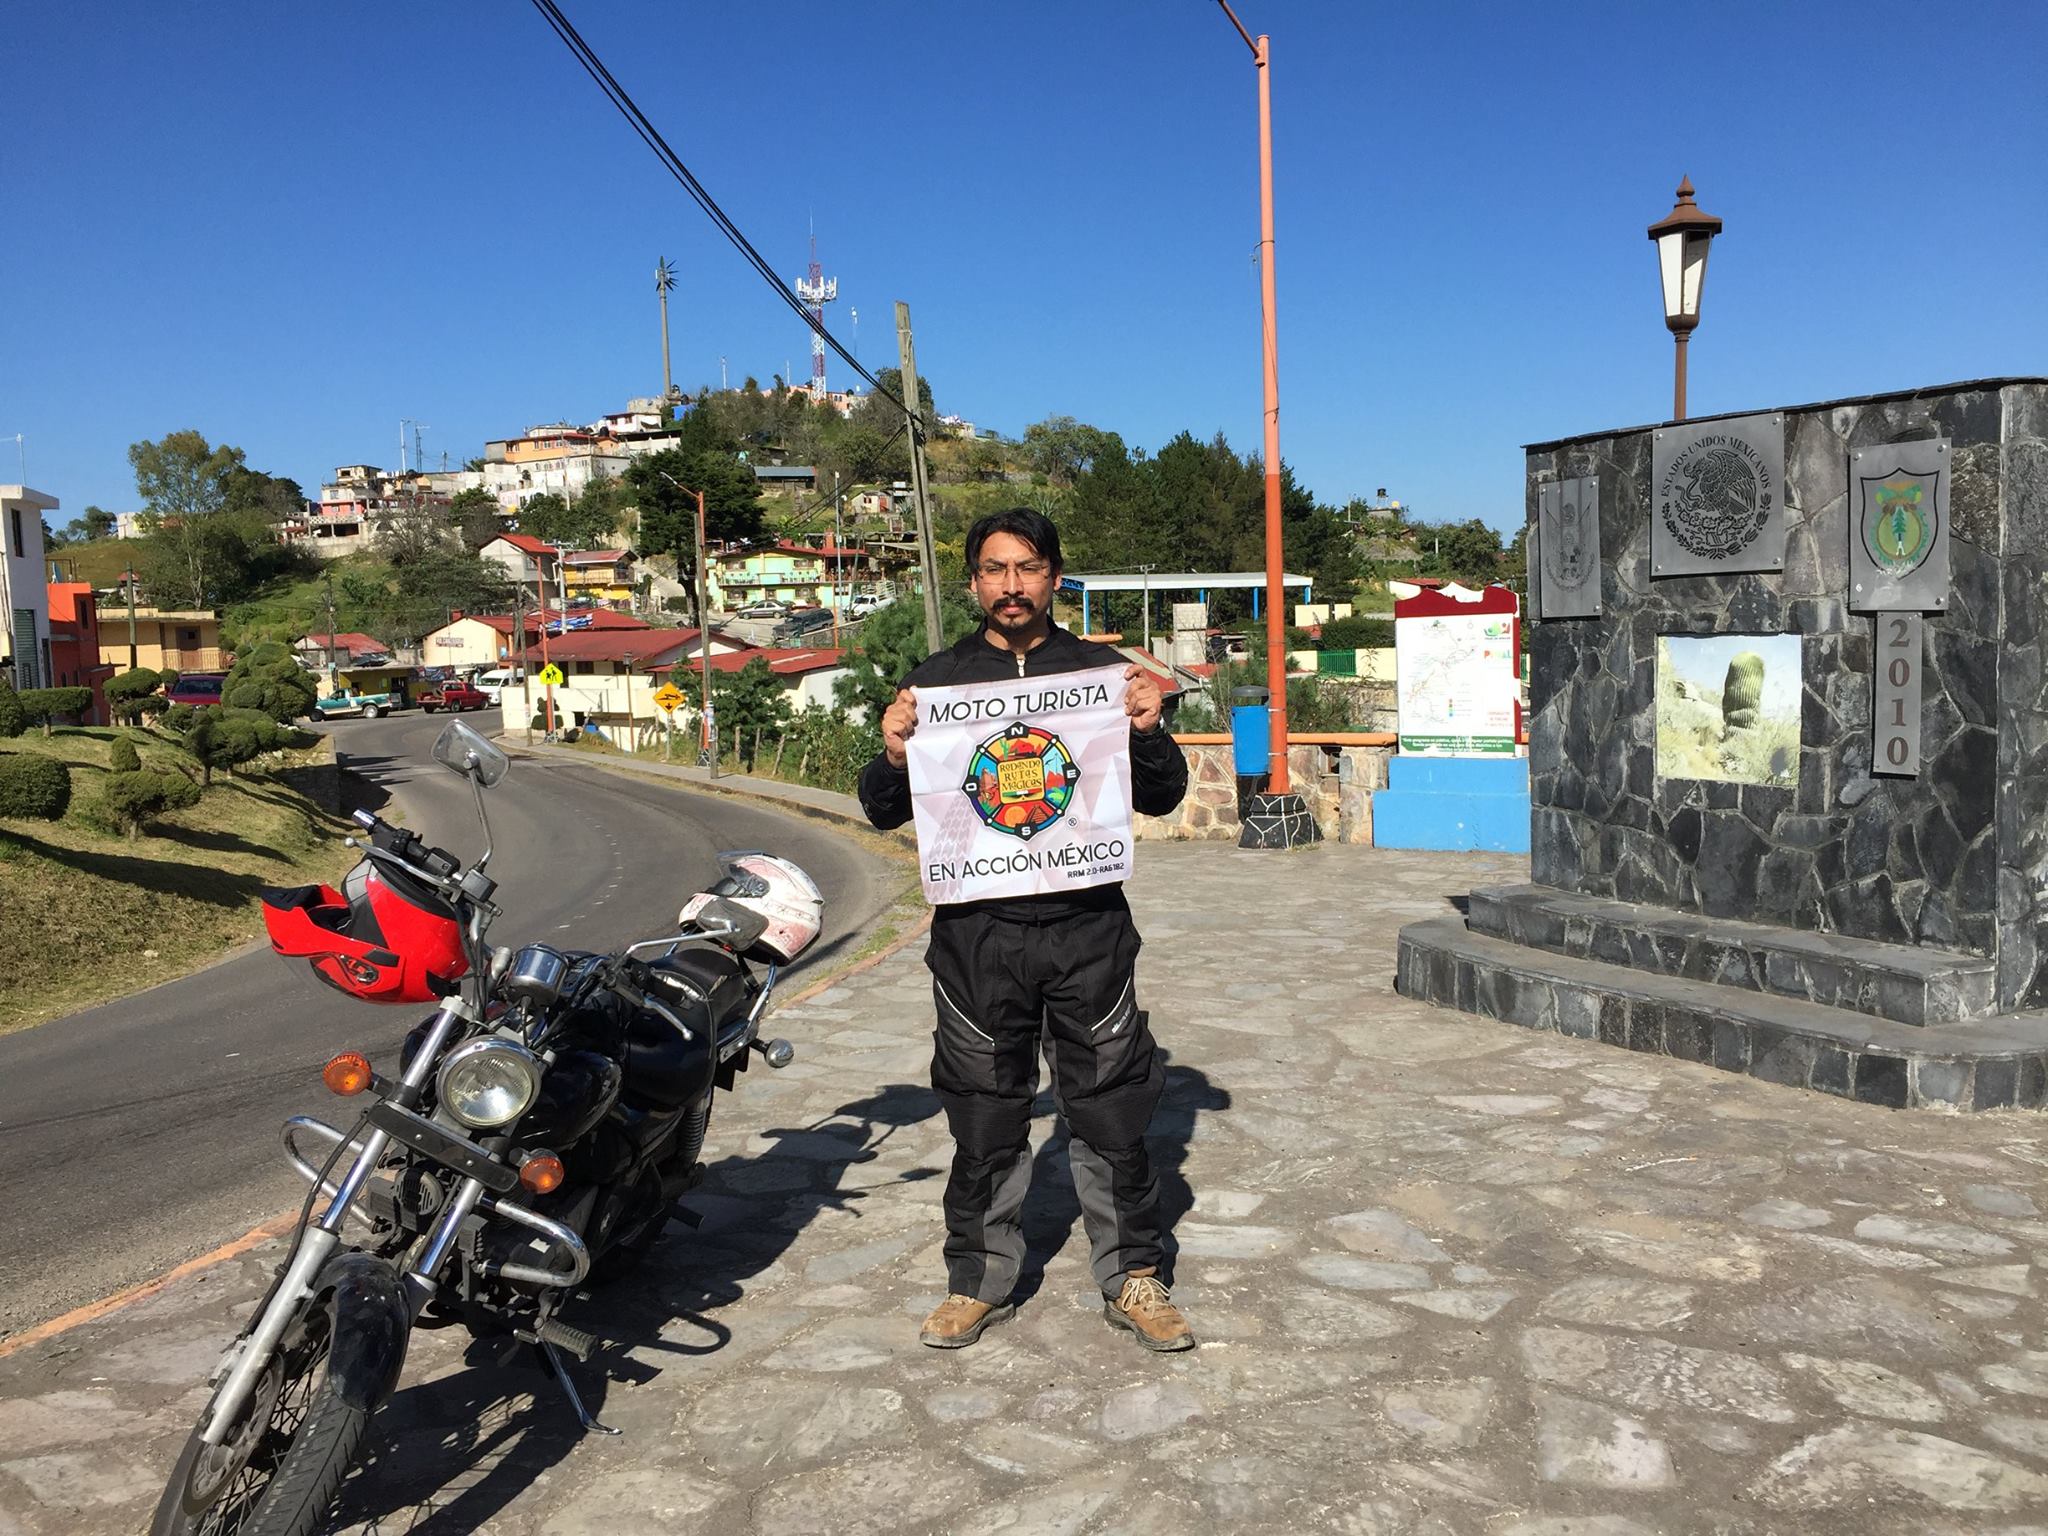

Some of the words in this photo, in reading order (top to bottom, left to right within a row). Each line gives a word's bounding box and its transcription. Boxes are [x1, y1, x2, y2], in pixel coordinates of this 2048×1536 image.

[1661, 450, 1688, 497] ESTADOS
[1688, 435, 1726, 454] UNIDOS
[1730, 437, 1771, 489] MEXICANOS
[929, 698, 1005, 724] MOTO
[1013, 684, 1109, 715] TURISTA
[1886, 618, 1911, 766] 2010
[1011, 726, 1024, 736] N
[1066, 769, 1077, 779] E
[1021, 826, 1032, 836] S
[929, 863, 956, 882] EN
[961, 849, 1042, 879] ACCIÓN
[1047, 840, 1125, 868] MÉXICO
[1067, 868, 1085, 879] RRM
